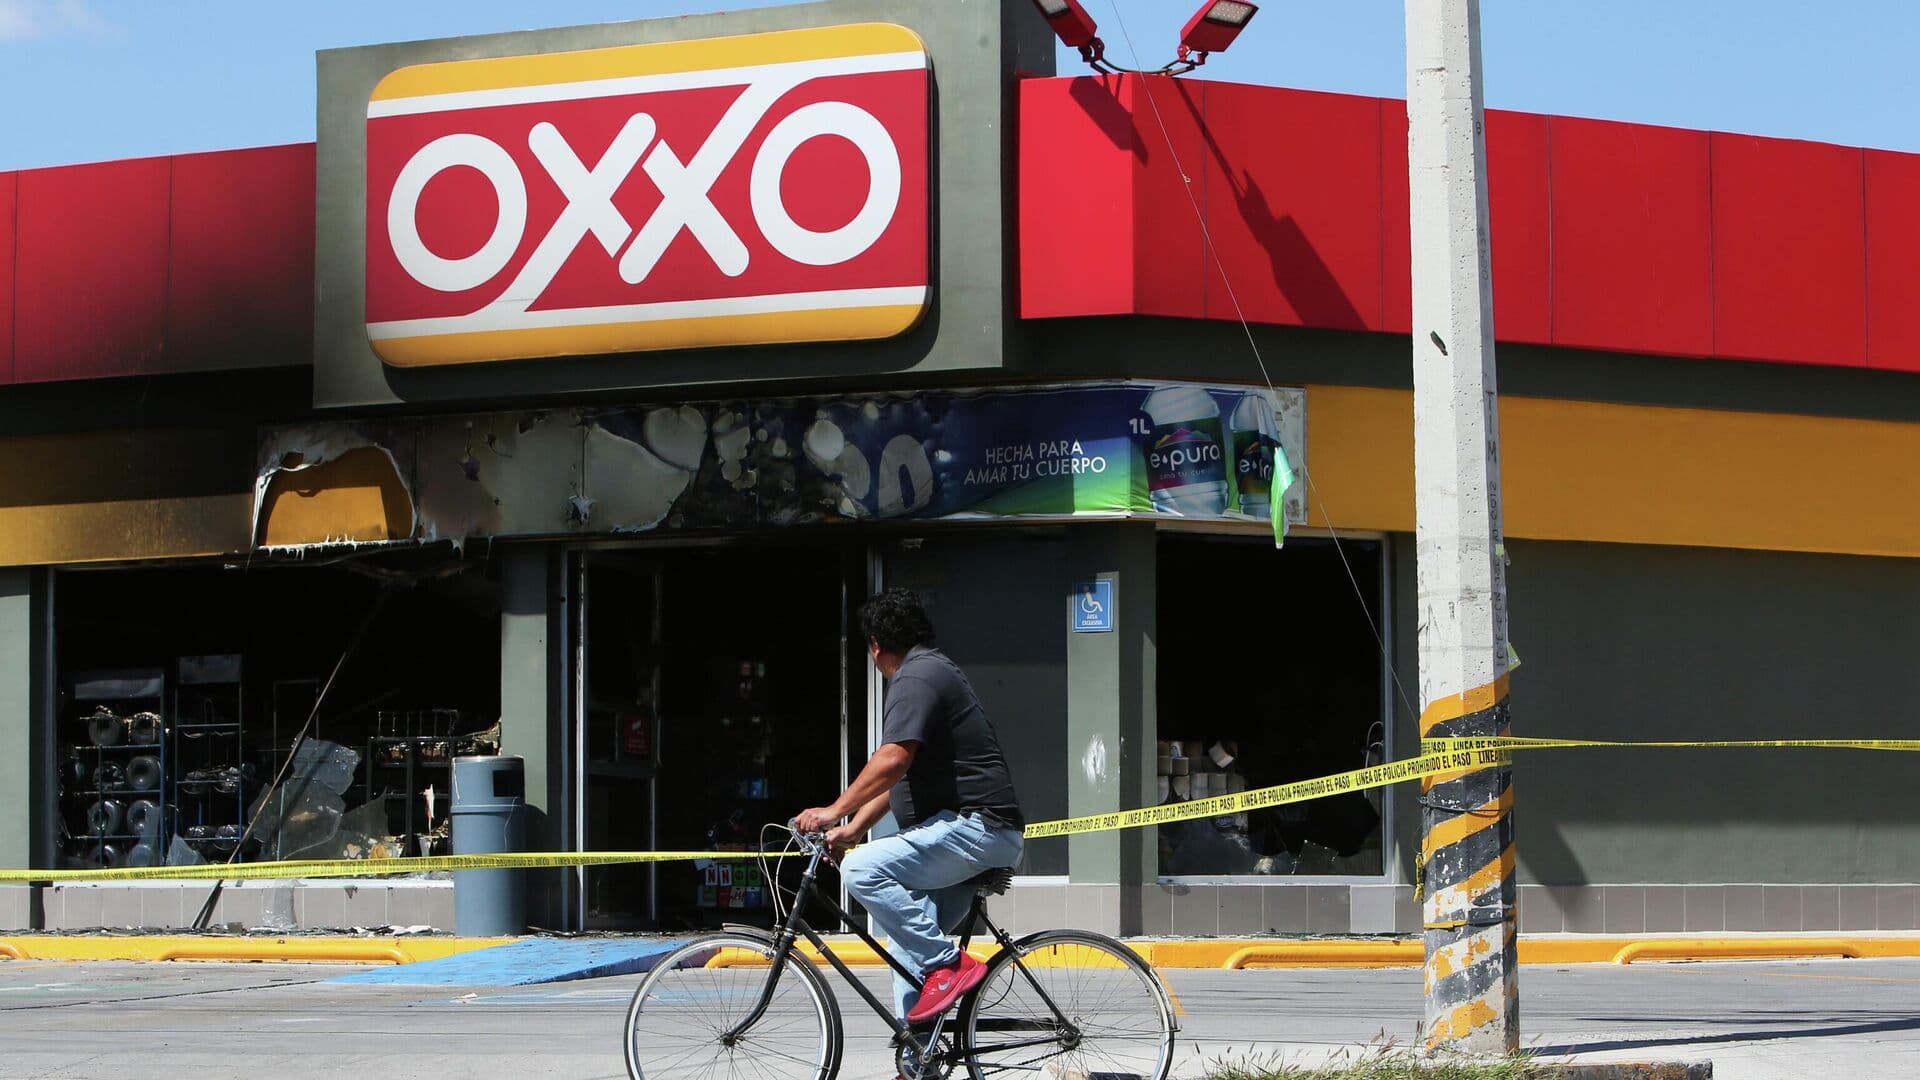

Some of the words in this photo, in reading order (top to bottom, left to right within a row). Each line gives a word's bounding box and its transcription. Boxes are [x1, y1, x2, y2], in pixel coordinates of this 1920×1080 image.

[387, 78, 901, 314] OXXO
[1129, 417, 1151, 435] 1L
[985, 442, 1034, 465] HECHA
[1039, 438, 1084, 459] PARA
[963, 466, 1009, 486] AMAR
[1011, 463, 1031, 481] TU
[1035, 456, 1107, 477] CUERPO
[1453, 740, 1473, 751] LINEA
[1025, 826, 1034, 837] DE
[1035, 824, 1059, 836] POLICIA
[1059, 818, 1094, 833] PROHIBIDO
[1094, 818, 1101, 830] EL
[1102, 815, 1119, 828] PASO
[1124, 812, 1142, 825] LINEA
[1143, 811, 1151, 822] DE
[1152, 807, 1176, 820] POLICIA
[1177, 802, 1210, 817] PROHIBIDO
[1211, 801, 1218, 812] EL
[1220, 797, 1235, 811] PASO
[1240, 793, 1258, 807] LINEA
[1258, 791, 1267, 804] DE
[1267, 787, 1292, 803] POLICIA
[1292, 781, 1326, 798] PROHIBIDO
[1326, 779, 1334, 792] EL
[1334, 775, 1351, 791] PASO
[1355, 770, 1374, 786] LINEA
[1373, 768, 1383, 782] DE
[1382, 763, 1407, 780] POLICIA
[1407, 756, 1441, 775] PROHIBIDO
[1442, 755, 1451, 769] EL
[1452, 752, 1471, 767] PASO
[1478, 749, 1498, 764] LINEA
